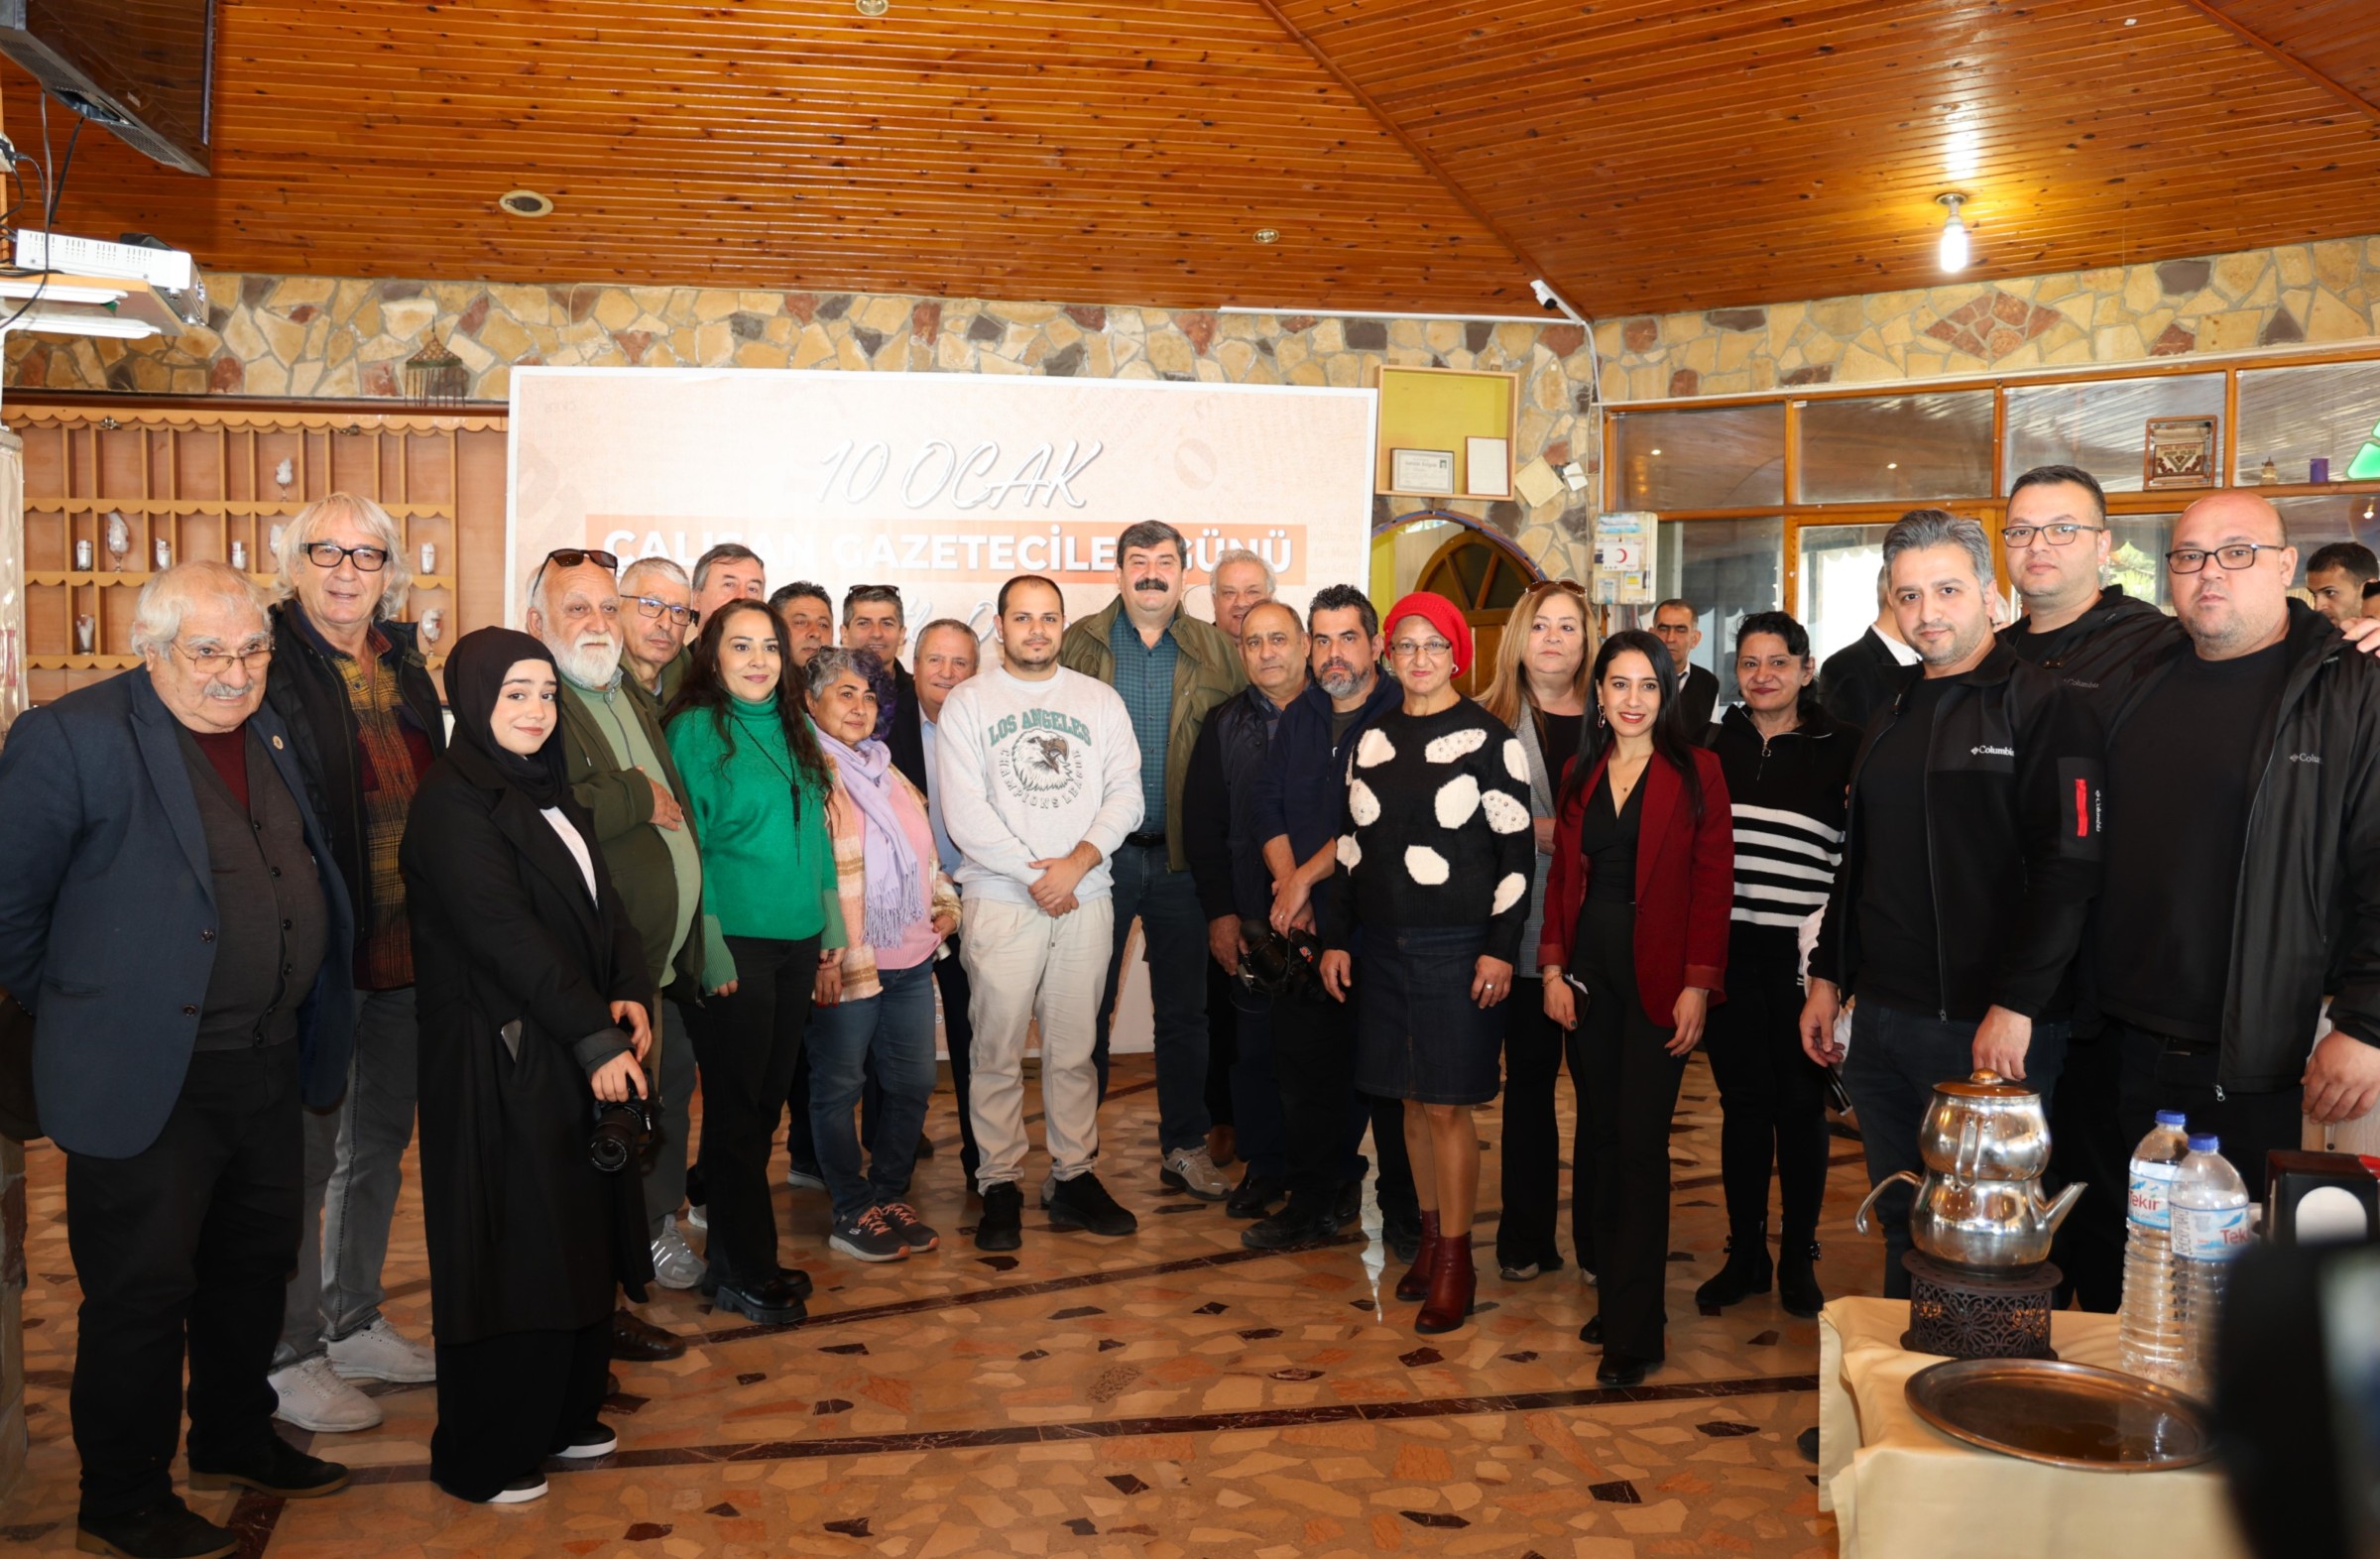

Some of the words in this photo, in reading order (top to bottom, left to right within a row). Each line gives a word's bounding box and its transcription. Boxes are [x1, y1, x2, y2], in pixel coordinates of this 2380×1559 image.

[817, 439, 890, 505] 10
[900, 437, 1104, 510] OCAK
[831, 524, 1119, 572] GAZETECİLE
[988, 714, 1017, 747] LOS
[1021, 708, 1092, 747] ANGELES
[2299, 753, 2320, 764] Colu
[2220, 1229, 2247, 1246] Tek
